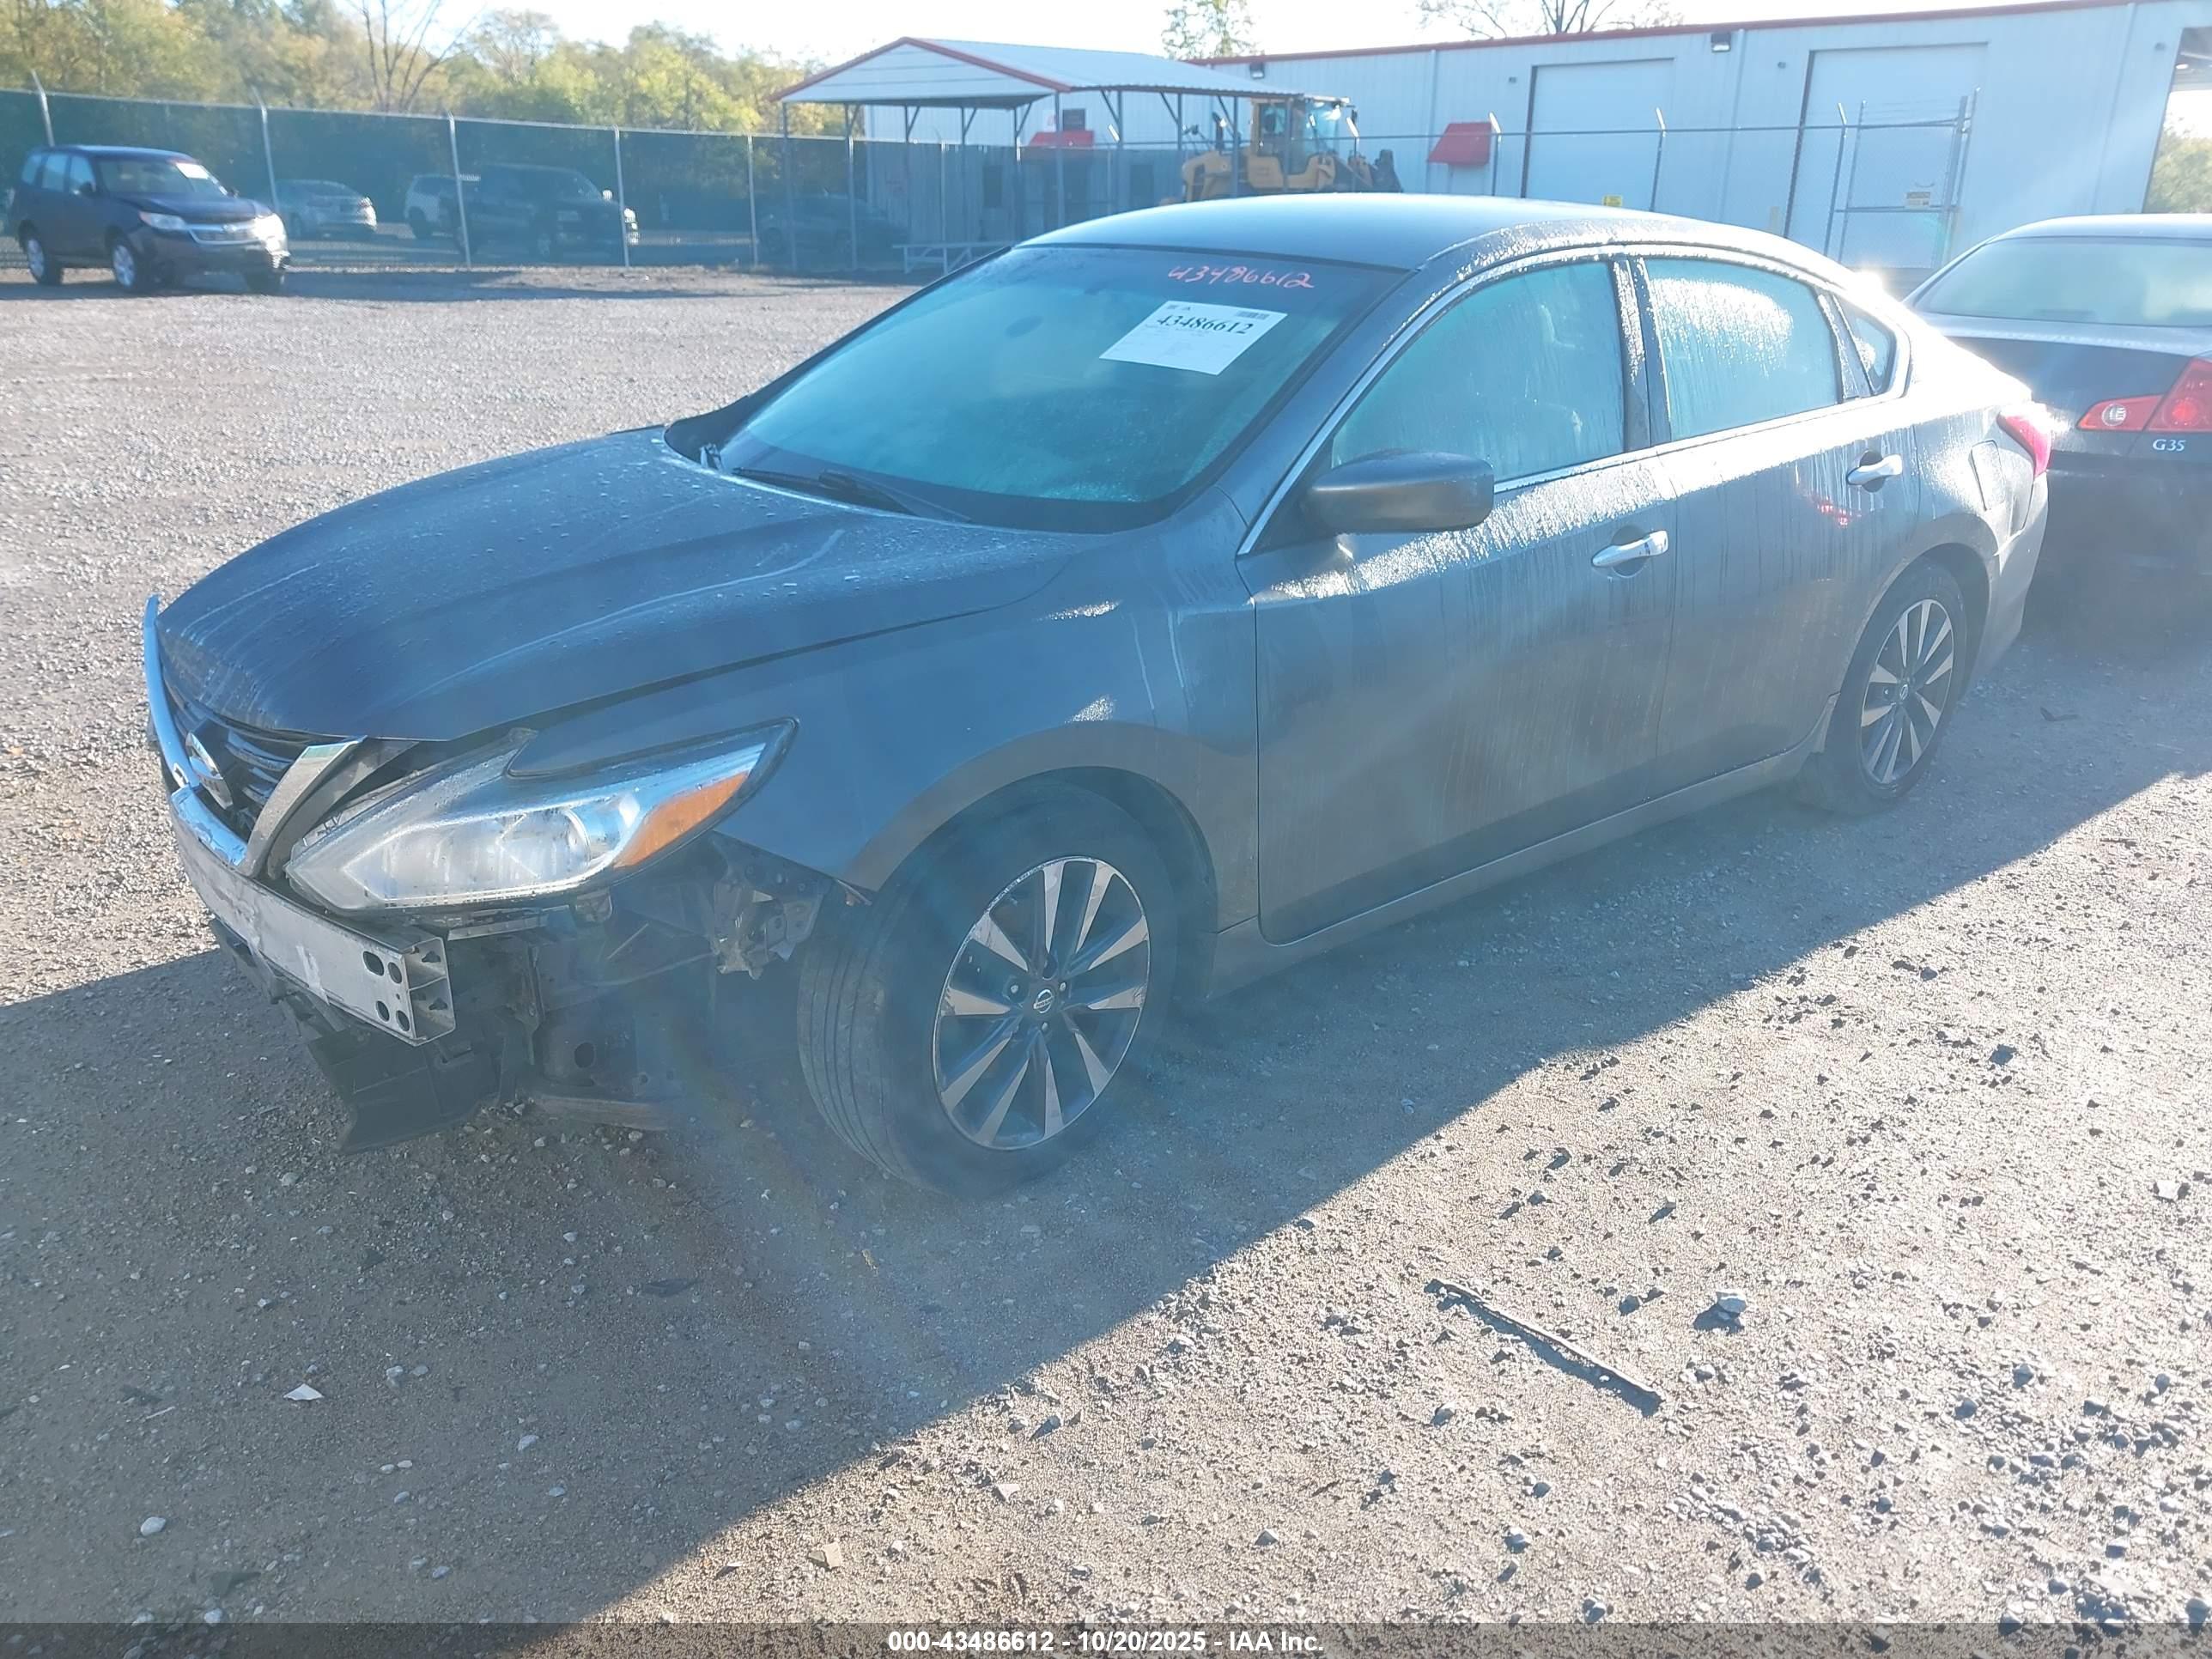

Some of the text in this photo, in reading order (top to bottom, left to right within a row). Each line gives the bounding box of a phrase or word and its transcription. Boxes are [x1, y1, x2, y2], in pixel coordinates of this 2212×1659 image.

[1168, 265, 1315, 289] 43486612
[1157, 314, 1255, 335] 43486612
[2152, 439, 2186, 452] G35
